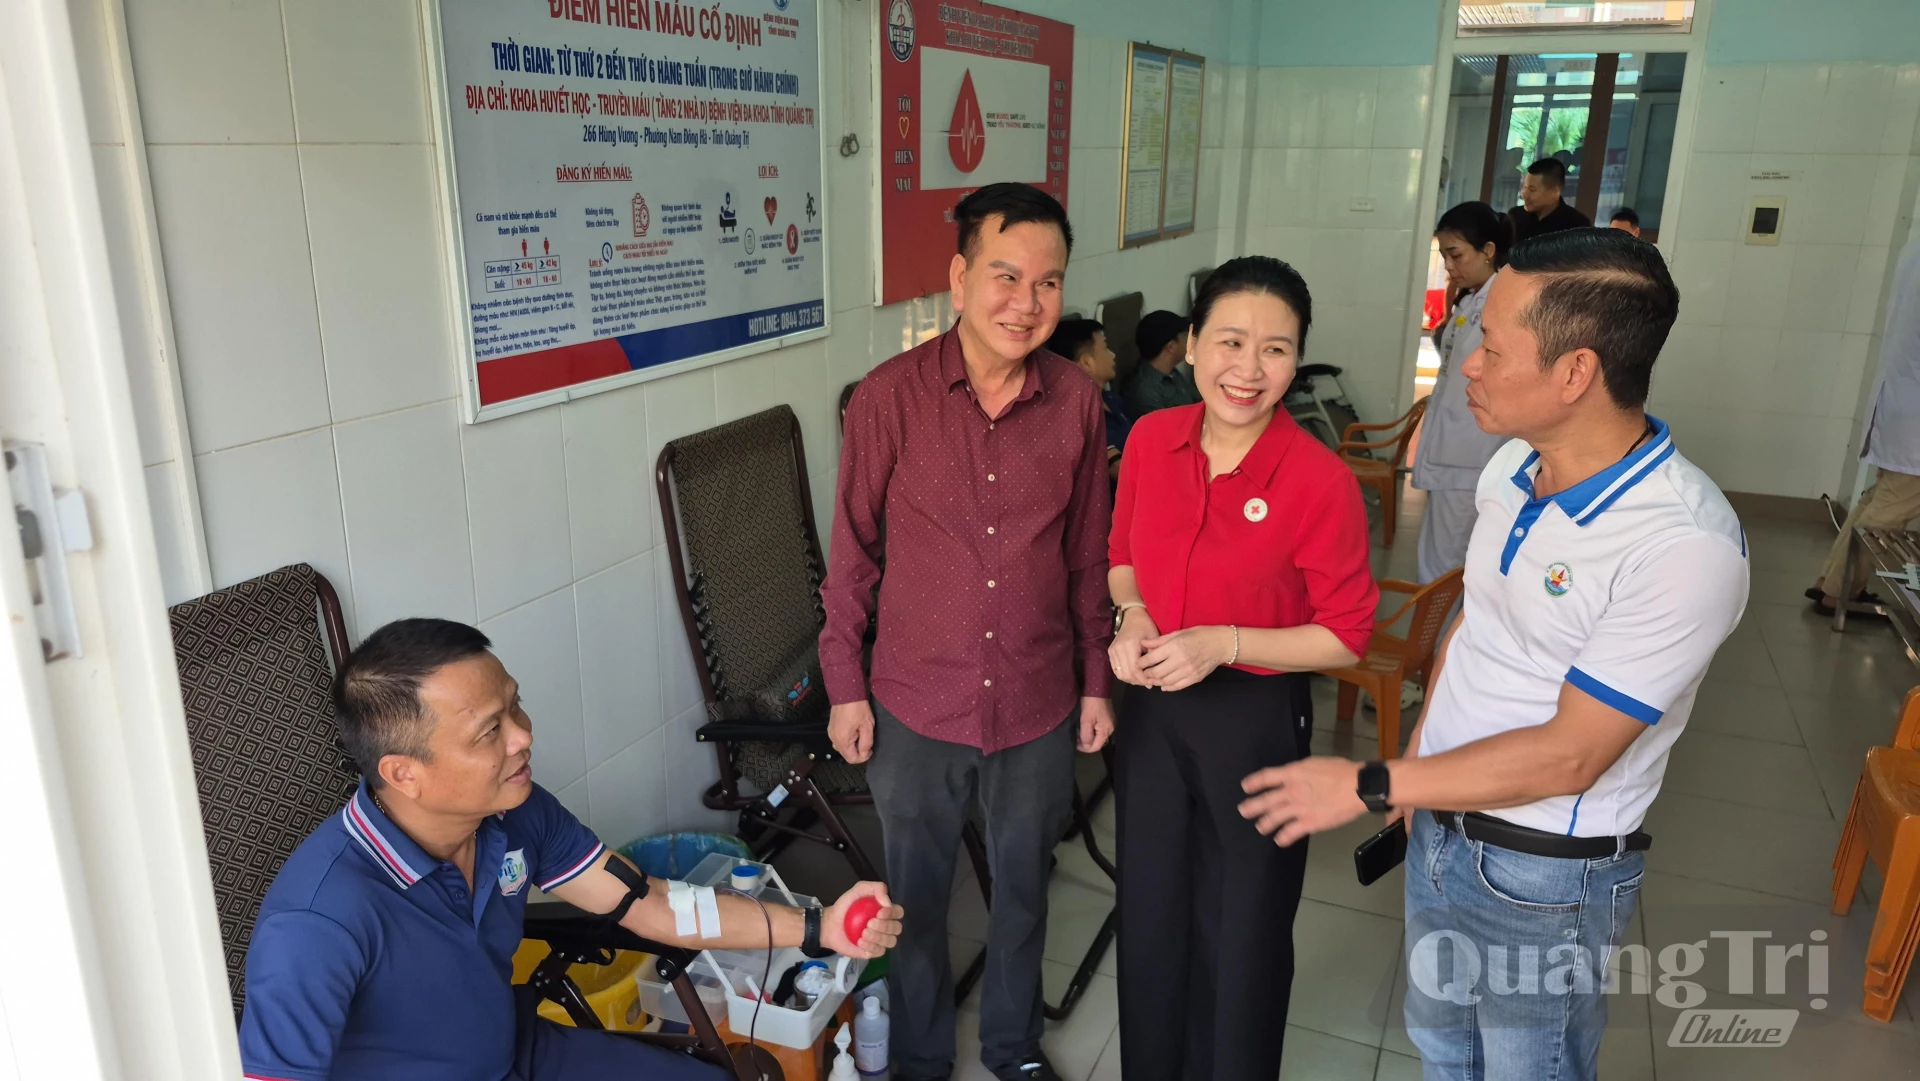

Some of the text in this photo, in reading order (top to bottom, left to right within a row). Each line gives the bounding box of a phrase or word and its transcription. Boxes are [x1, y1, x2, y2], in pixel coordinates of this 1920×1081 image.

[655, 0, 695, 37] MÁU
[700, 2, 721, 41] CỐ
[725, 13, 761, 51] ĐỊNH
[492, 37, 520, 72] THỜI
[523, 45, 555, 75] GIAN:
[557, 44, 571, 76] TỪ
[573, 47, 594, 78] THỨ
[597, 53, 604, 79] 2
[606, 47, 626, 80] ĐẾN
[628, 53, 647, 82] THỨ
[649, 59, 655, 83] 6
[657, 55, 682, 85] HÀNG
[709, 65, 738, 90] (TRONG
[740, 64, 752, 91] GIỜ
[754, 66, 774, 93] HÀNH
[776, 70, 799, 97] CHÍNH)
[466, 85, 486, 114] ĐỊA
[488, 80, 508, 110] CHỈ:
[510, 88, 538, 112] KHOA
[540, 85, 569, 113] HUYẾT
[572, 92, 590, 119] HỌC
[598, 89, 630, 116] TRUYỀN
[632, 92, 650, 117] MÁU
[678, 99, 682, 118] 2
[684, 96, 699, 120] NHÀ
[709, 97, 726, 124] BỆNH
[728, 99, 742, 125] VIỆN
[744, 103, 753, 122] ĐA
[754, 104, 770, 123] KHOA
[771, 101, 785, 123] TỈNH
[786, 102, 804, 126] QUẢNG
[805, 107, 814, 128] TRỊ
[897, 94, 912, 112] TÔI
[583, 124, 597, 142] 266
[599, 125, 616, 147] Hùng
[618, 126, 638, 148] Vương
[644, 127, 667, 148] Phường
[669, 128, 682, 143] Nam
[684, 128, 698, 148] Đông
[700, 129, 707, 144] Hà
[712, 129, 723, 144] Tỉnh
[725, 130, 741, 149] Quảng
[895, 147, 914, 164] HIẾN
[556, 161, 632, 180] ĐĂNG KÝ HIẾN MÁU:
[896, 174, 913, 191] MÁU
[749, 306, 822, 337] HOTLINE: 0844 373 567
